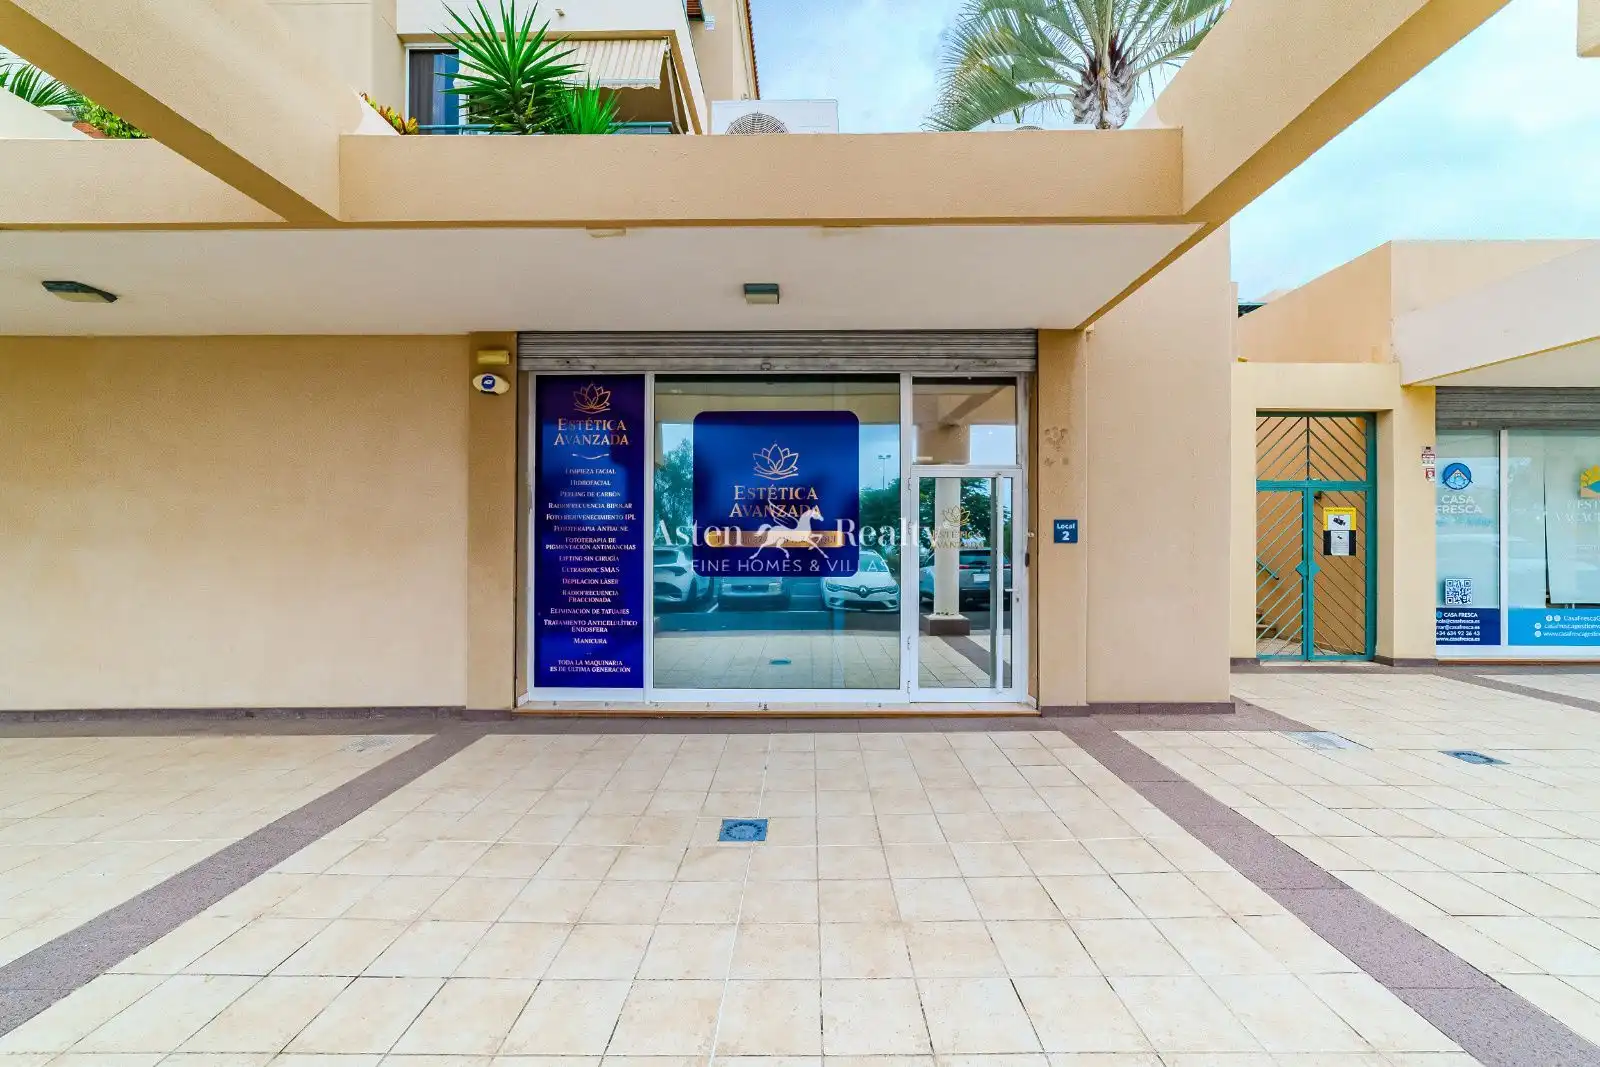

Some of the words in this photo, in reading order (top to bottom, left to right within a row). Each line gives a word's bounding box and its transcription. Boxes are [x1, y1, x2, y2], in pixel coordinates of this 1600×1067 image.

[733, 484, 819, 500] ESTÉTICA
[1441, 494, 1475, 504] CASA
[1436, 504, 1483, 514] FRESCA
[1062, 530, 1070, 541] 2
